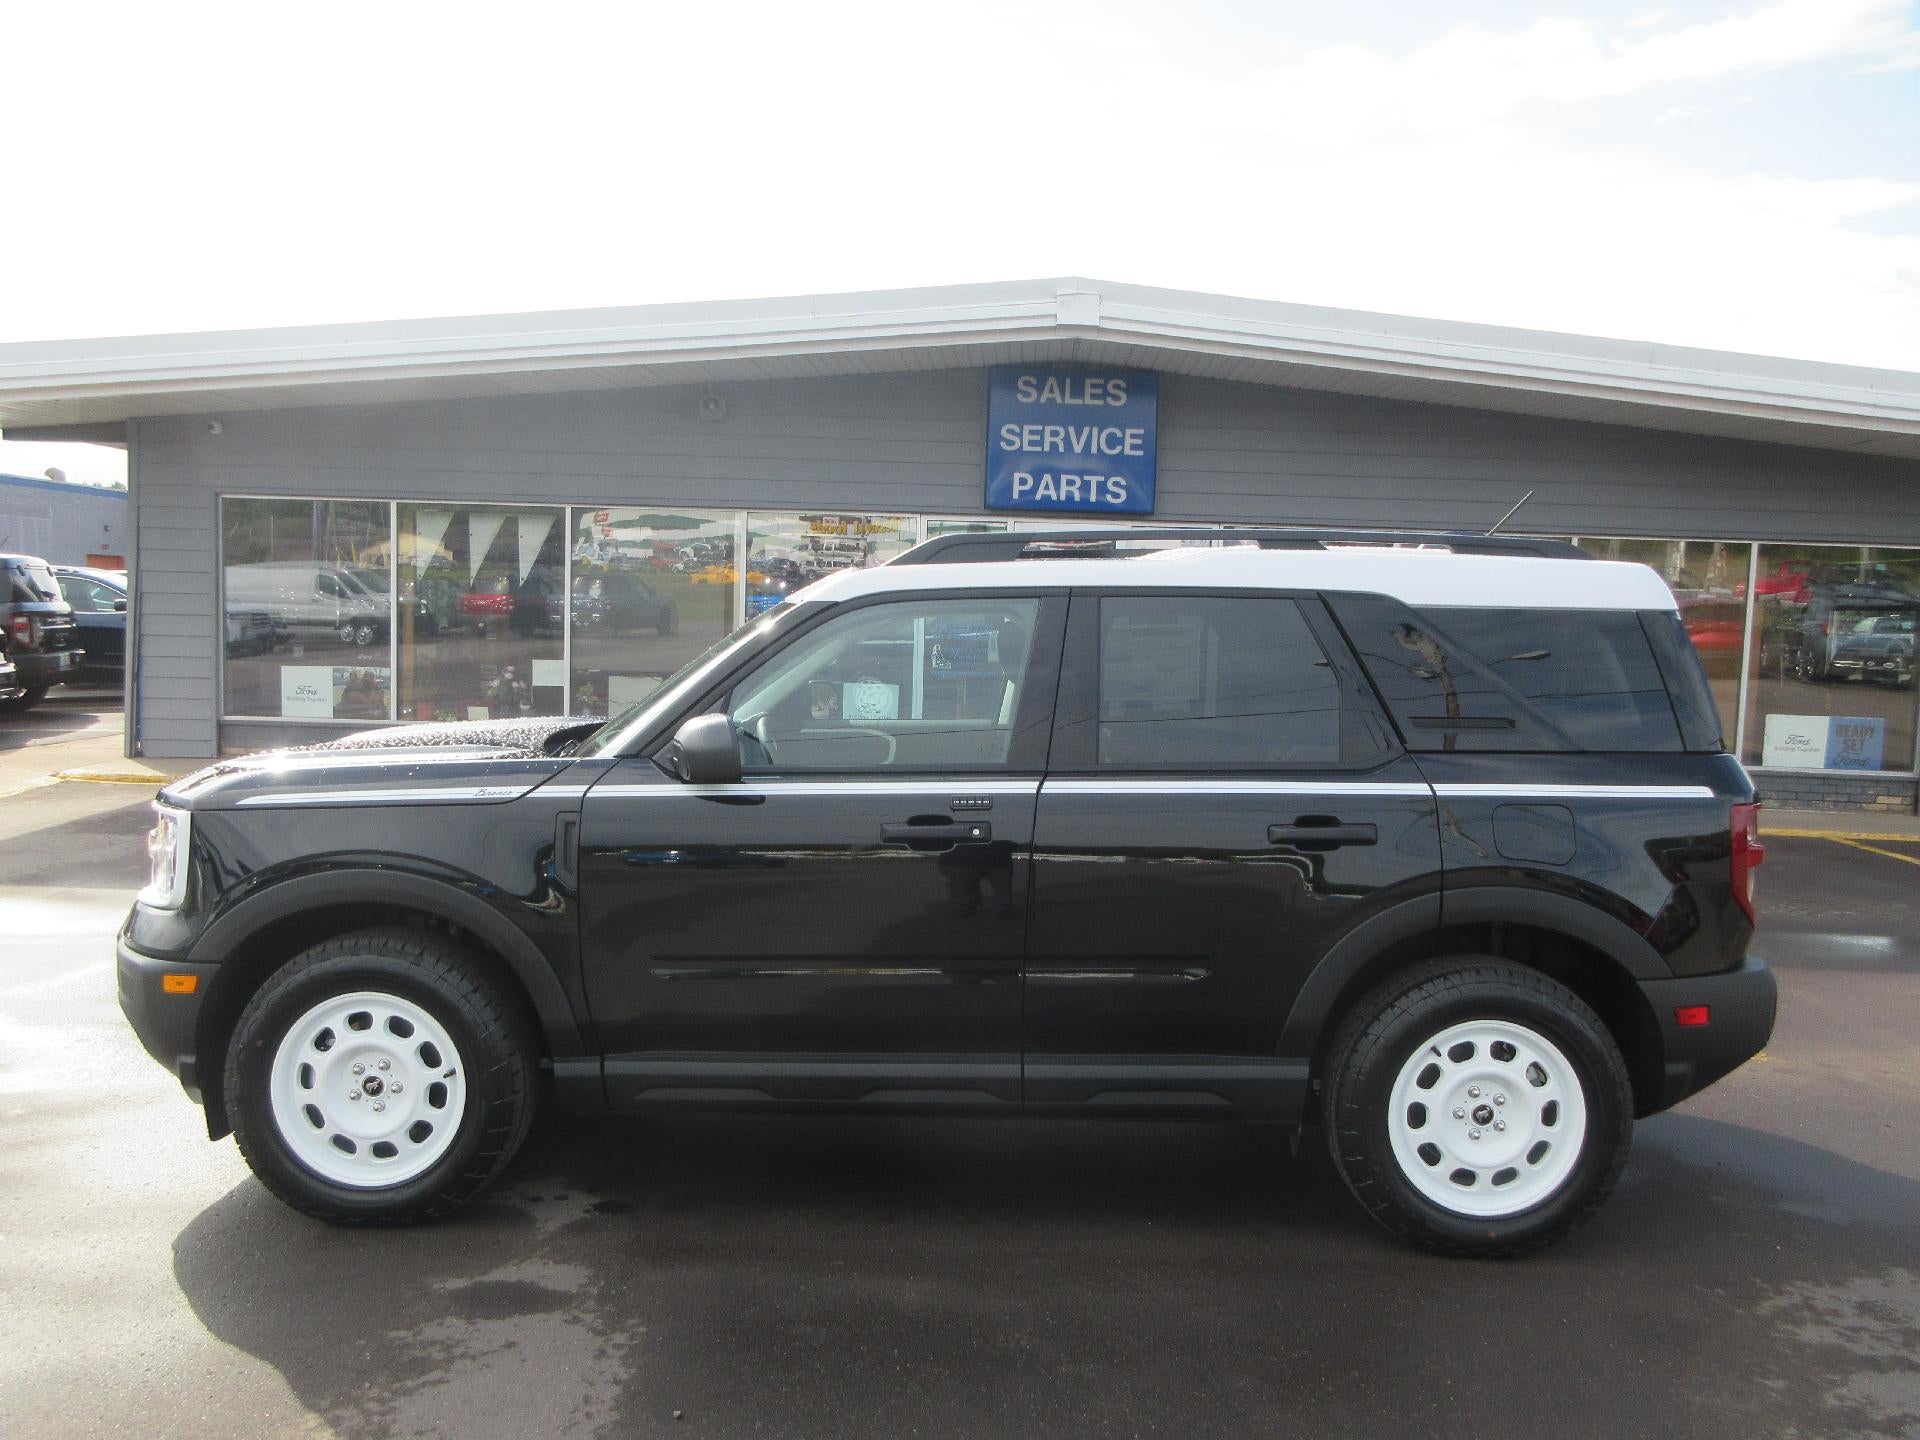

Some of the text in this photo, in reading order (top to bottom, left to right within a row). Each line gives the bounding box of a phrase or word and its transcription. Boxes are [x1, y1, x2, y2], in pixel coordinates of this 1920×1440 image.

[1016, 375, 1128, 407] SALES
[1000, 423, 1145, 456] SERVICE
[1012, 472, 1128, 504] PARTS
[295, 684, 319, 696] Ford
[1836, 724, 1875, 738] READY
[1784, 734, 1811, 746] Ford
[473, 788, 513, 797] Bronco
